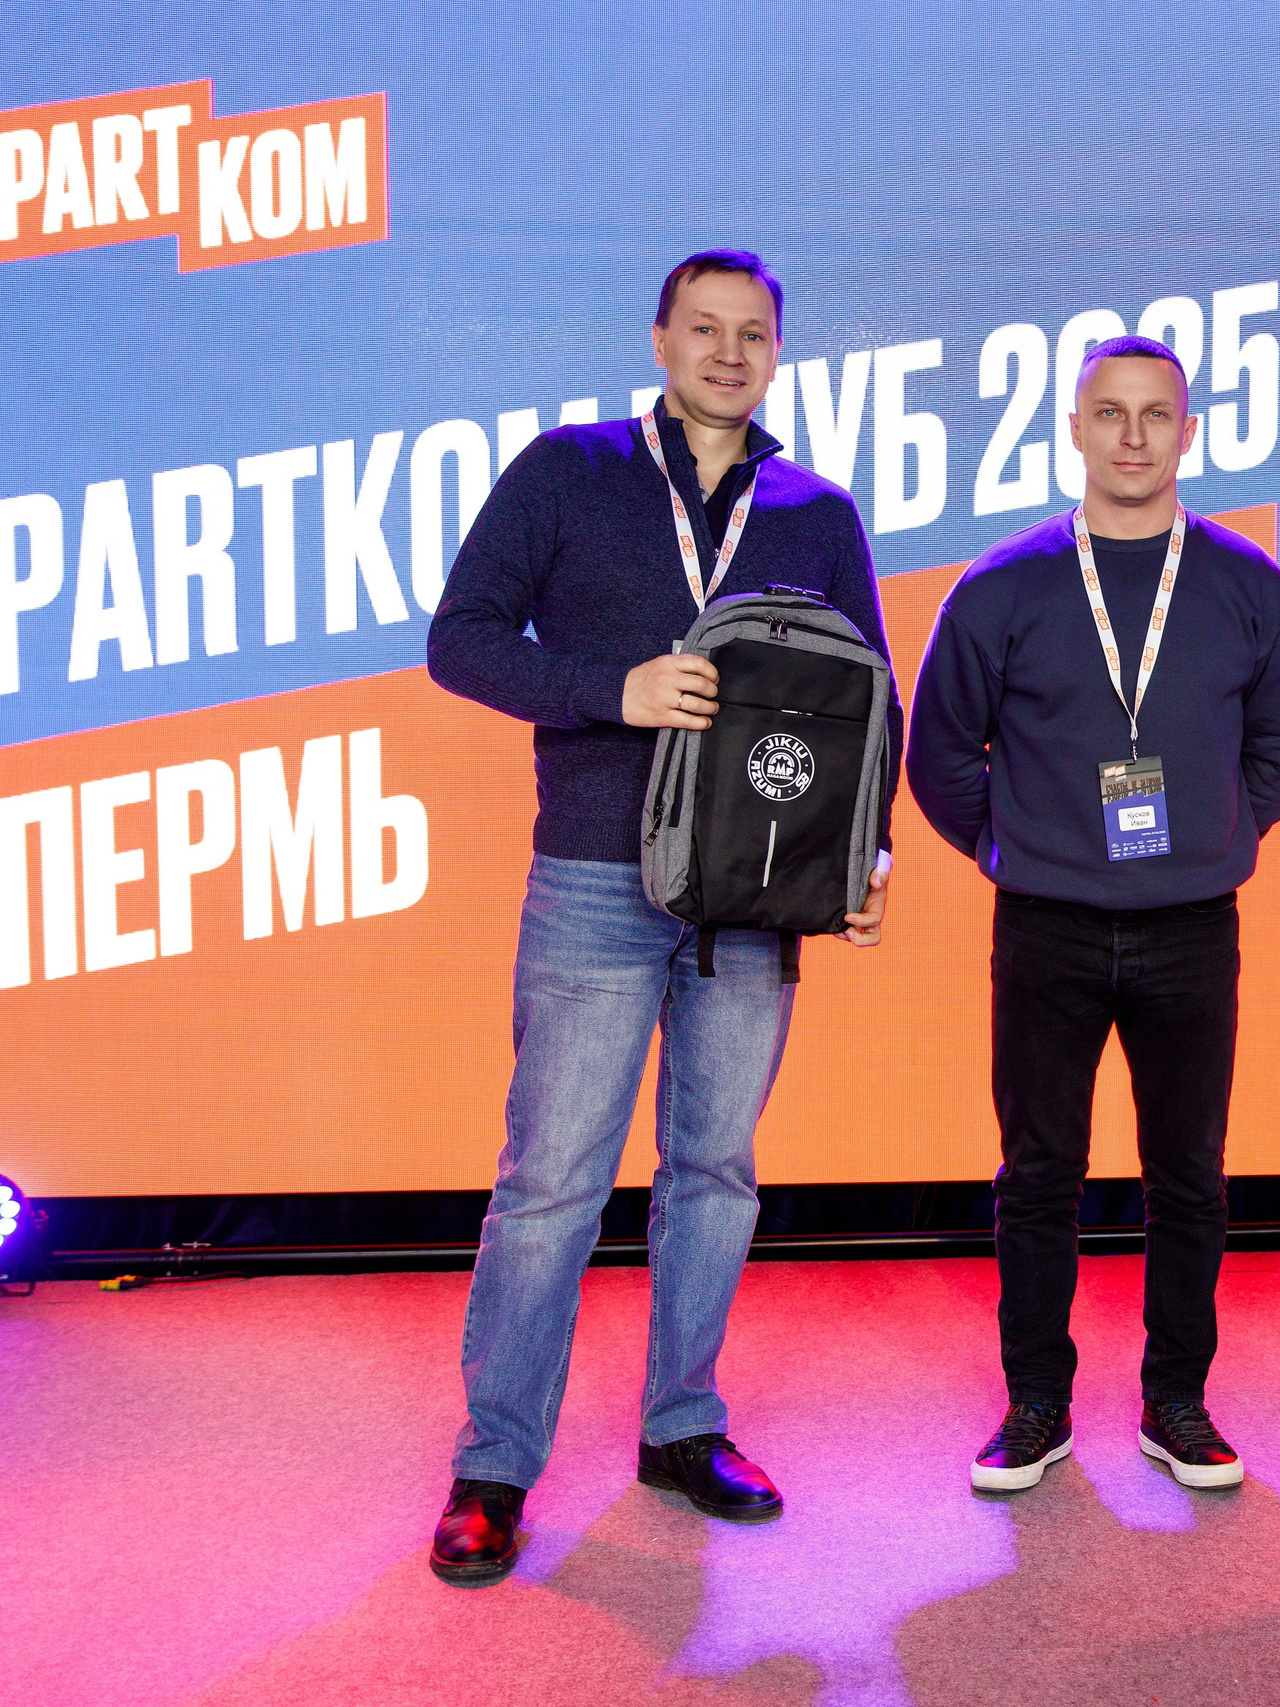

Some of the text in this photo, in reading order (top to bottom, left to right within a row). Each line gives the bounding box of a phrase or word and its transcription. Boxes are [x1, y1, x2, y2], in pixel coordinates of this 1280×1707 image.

[0, 104, 367, 248] PART KOM
[0, 397, 598, 695] PARTKO
[765, 736, 809, 759] JIKIU
[750, 760, 782, 798] AZUMI
[767, 762, 794, 775] RMP
[1127, 811, 1150, 820] Кусков
[0, 727, 428, 989] ПЕРМЬ
